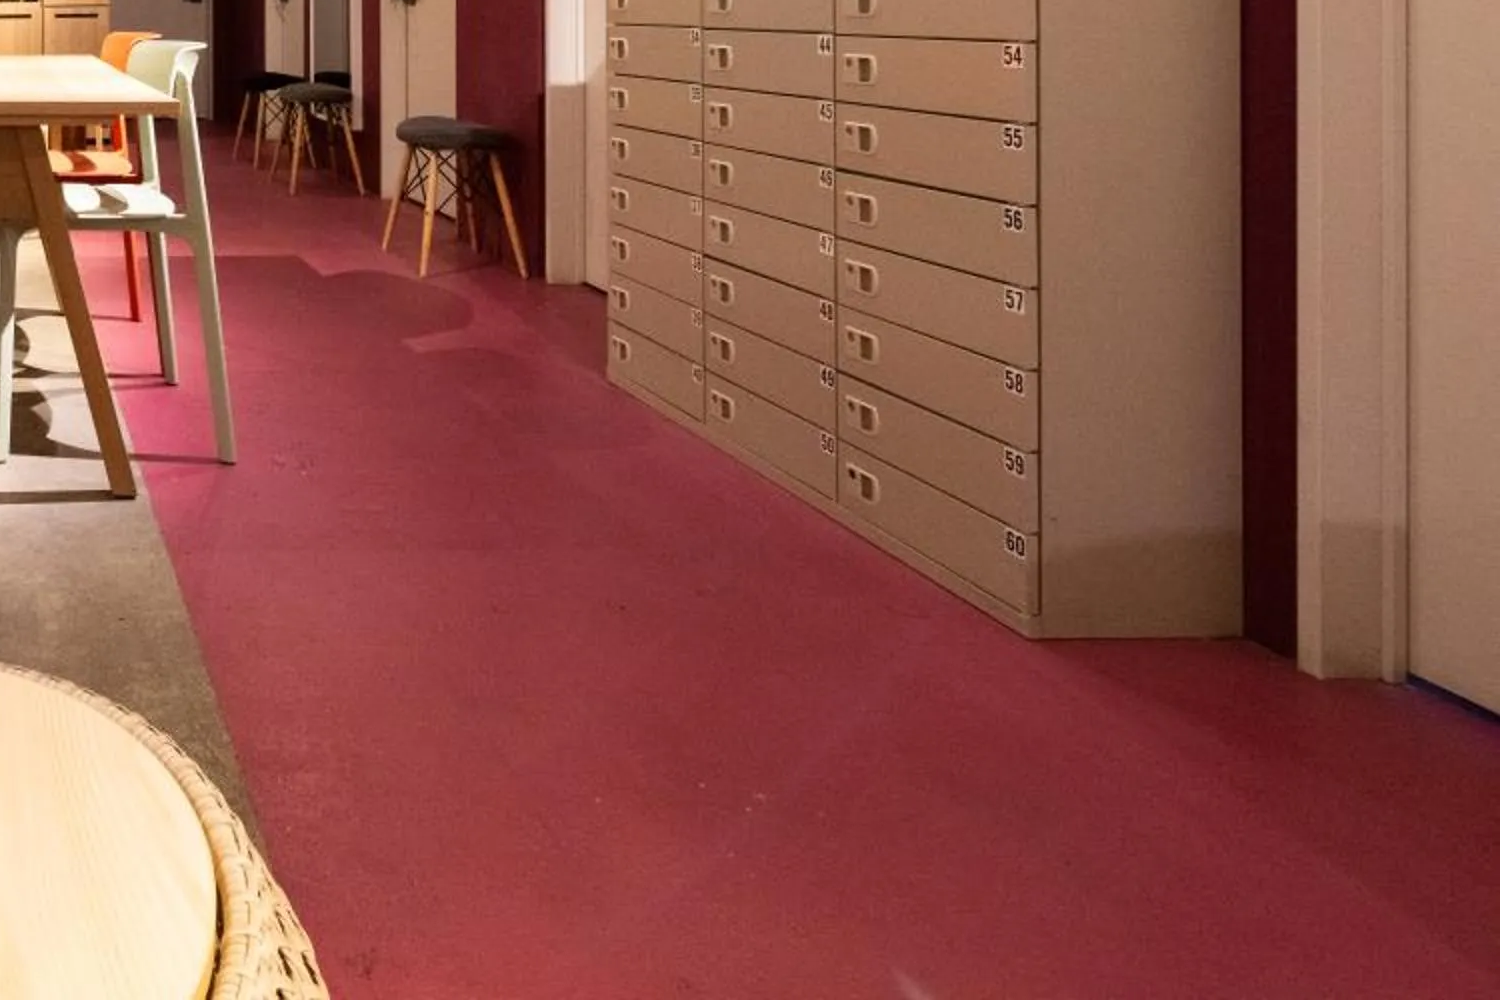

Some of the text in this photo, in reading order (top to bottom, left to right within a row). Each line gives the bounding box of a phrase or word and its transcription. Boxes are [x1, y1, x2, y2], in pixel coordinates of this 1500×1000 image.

[1004, 45, 1022, 65] 54
[1004, 127, 1022, 148] 55
[1004, 208, 1022, 230] 56
[1005, 289, 1023, 311] 57
[1005, 370, 1023, 393] 58
[1005, 450, 1024, 475] 59
[1006, 531, 1025, 556] 60
